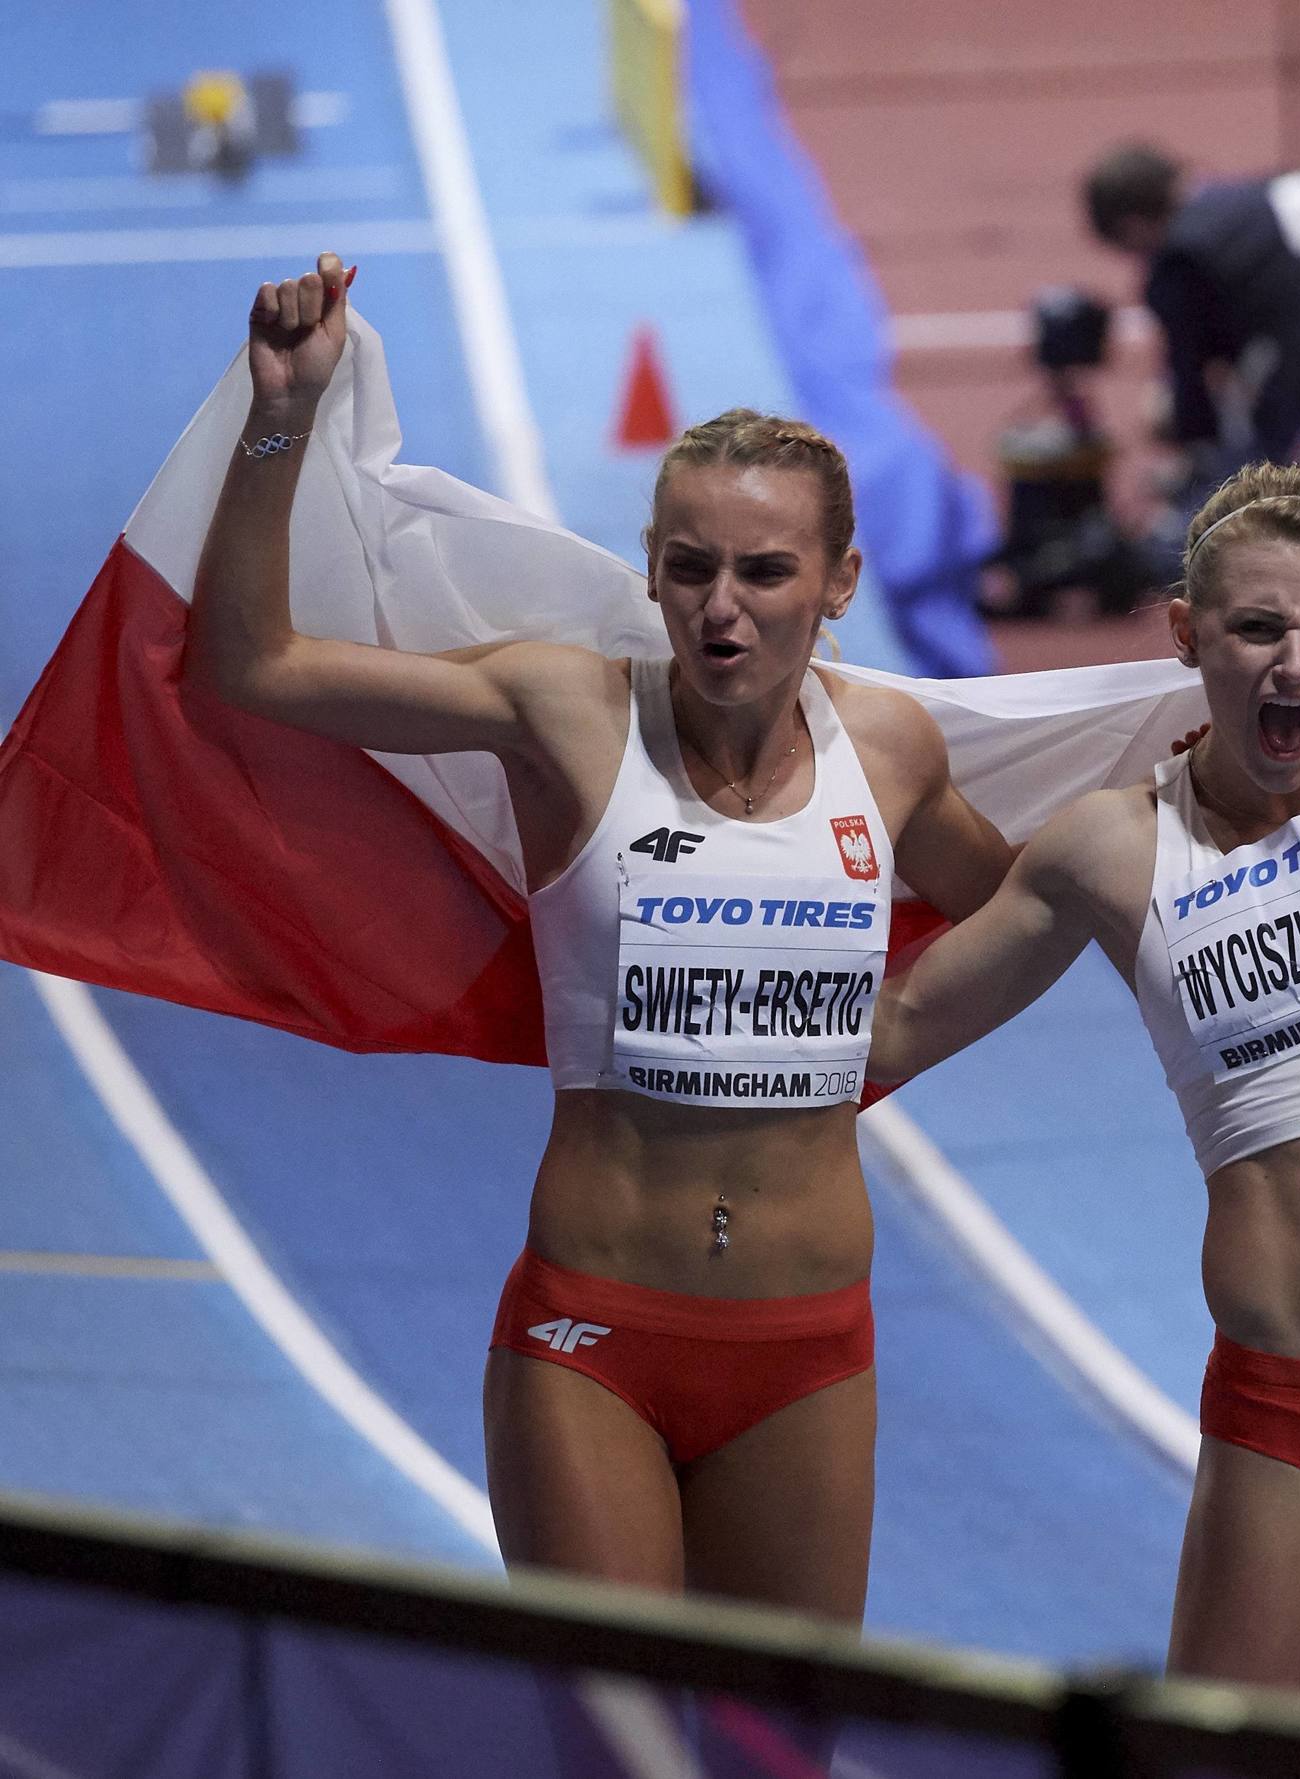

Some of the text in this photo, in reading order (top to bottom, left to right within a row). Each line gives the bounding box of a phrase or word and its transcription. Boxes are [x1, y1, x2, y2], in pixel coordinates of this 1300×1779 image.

[834, 819, 865, 829] POLSKA
[629, 827, 706, 863] 4F
[1174, 858, 1278, 920] TOYO
[636, 897, 876, 930] TOYO TIRES
[622, 965, 874, 1038] SWIETY-ERSETIC
[629, 1066, 857, 1098] BIRMINGHAM 2018
[527, 1317, 612, 1354] 4F
